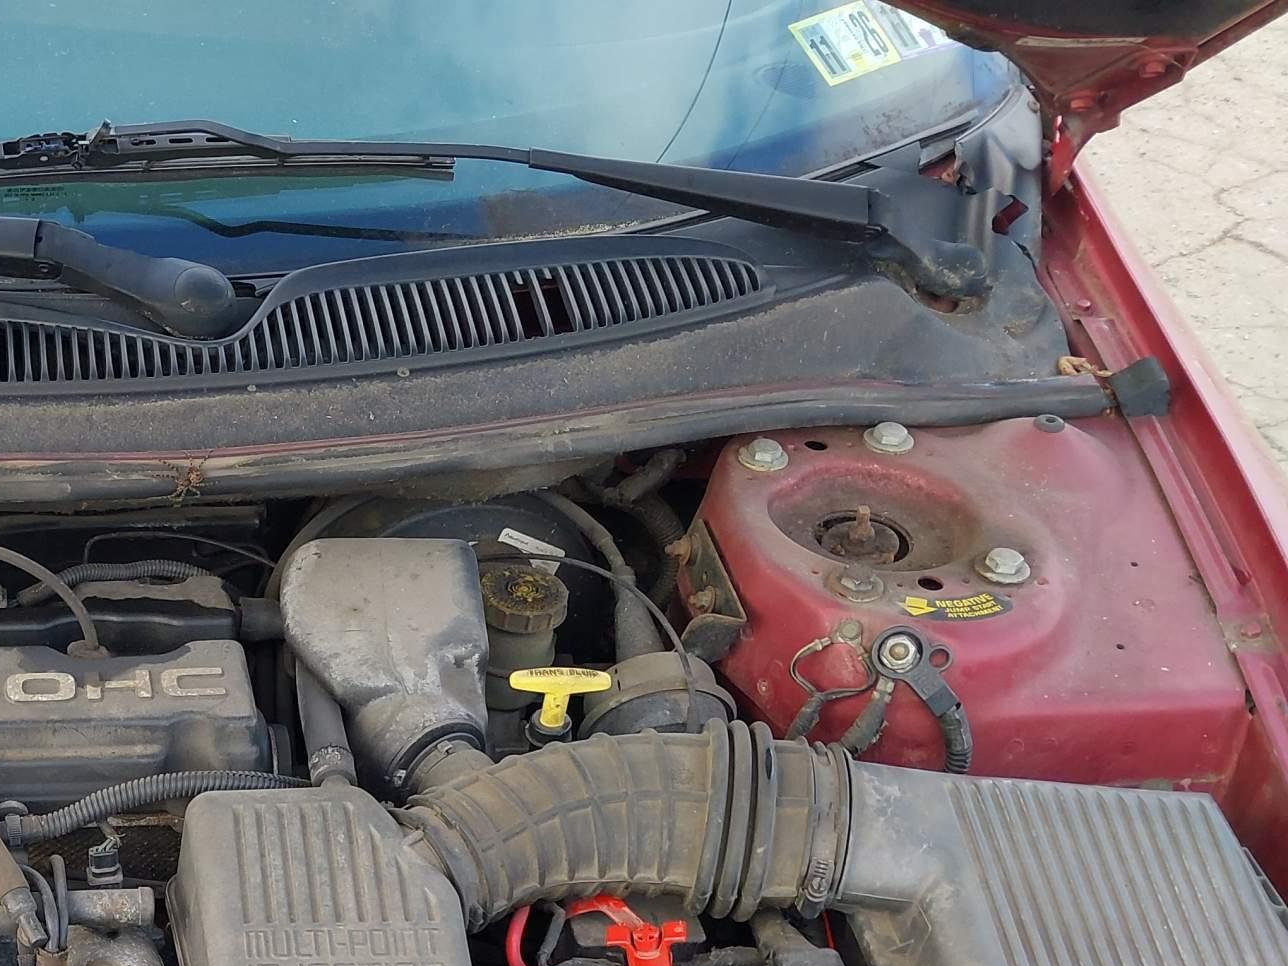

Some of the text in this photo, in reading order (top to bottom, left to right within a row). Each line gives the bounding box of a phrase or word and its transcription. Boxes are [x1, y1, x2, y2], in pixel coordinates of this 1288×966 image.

[848, 11, 889, 56] 26
[935, 592, 994, 608] NEGATIVE
[947, 605, 1004, 618] ATTACHMENT
